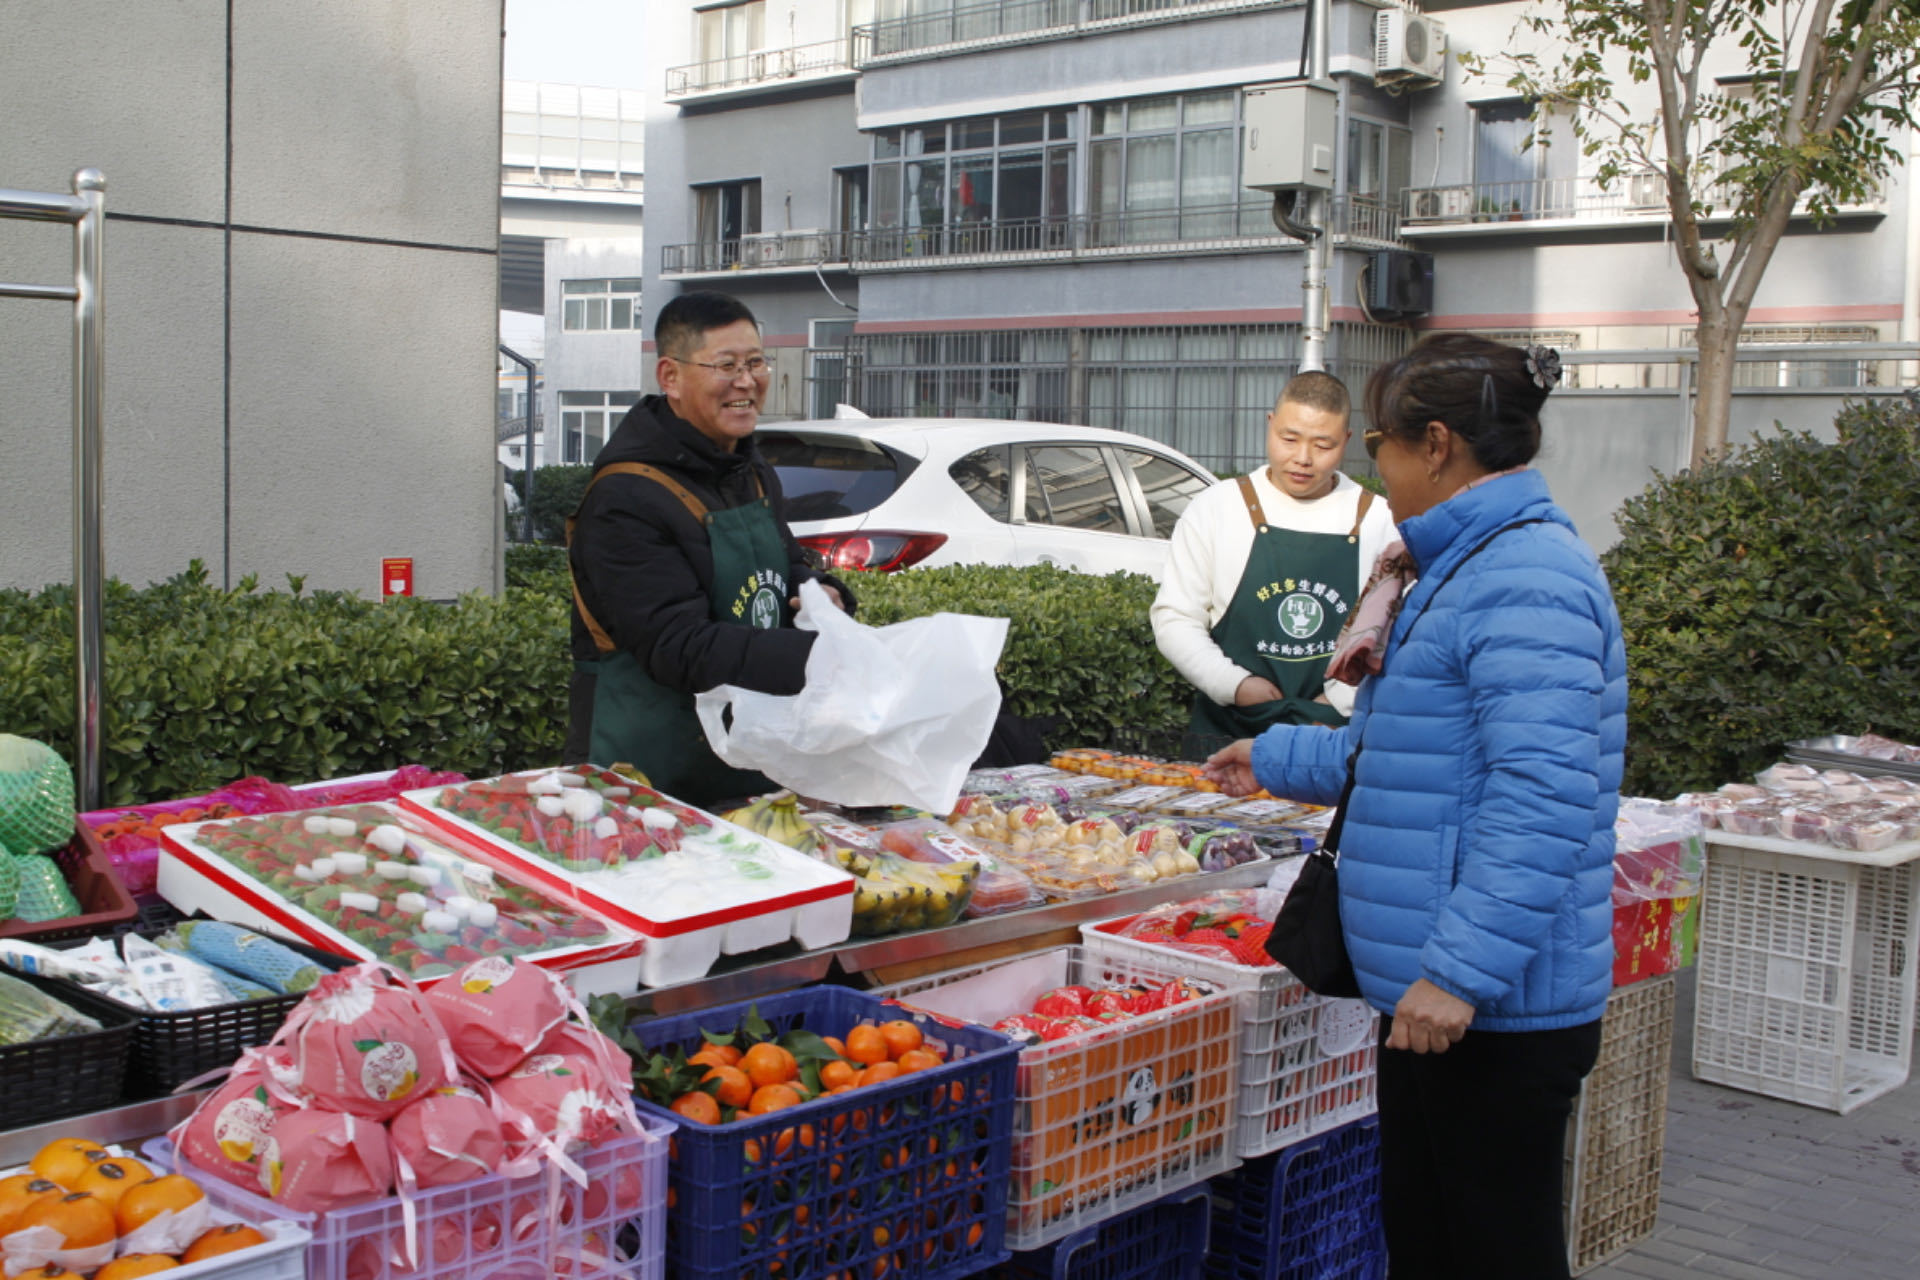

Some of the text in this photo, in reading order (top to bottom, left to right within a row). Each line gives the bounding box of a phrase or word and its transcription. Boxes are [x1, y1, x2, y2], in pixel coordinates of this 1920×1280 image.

[1256, 578, 1348, 614] 好又多生鲜超市
